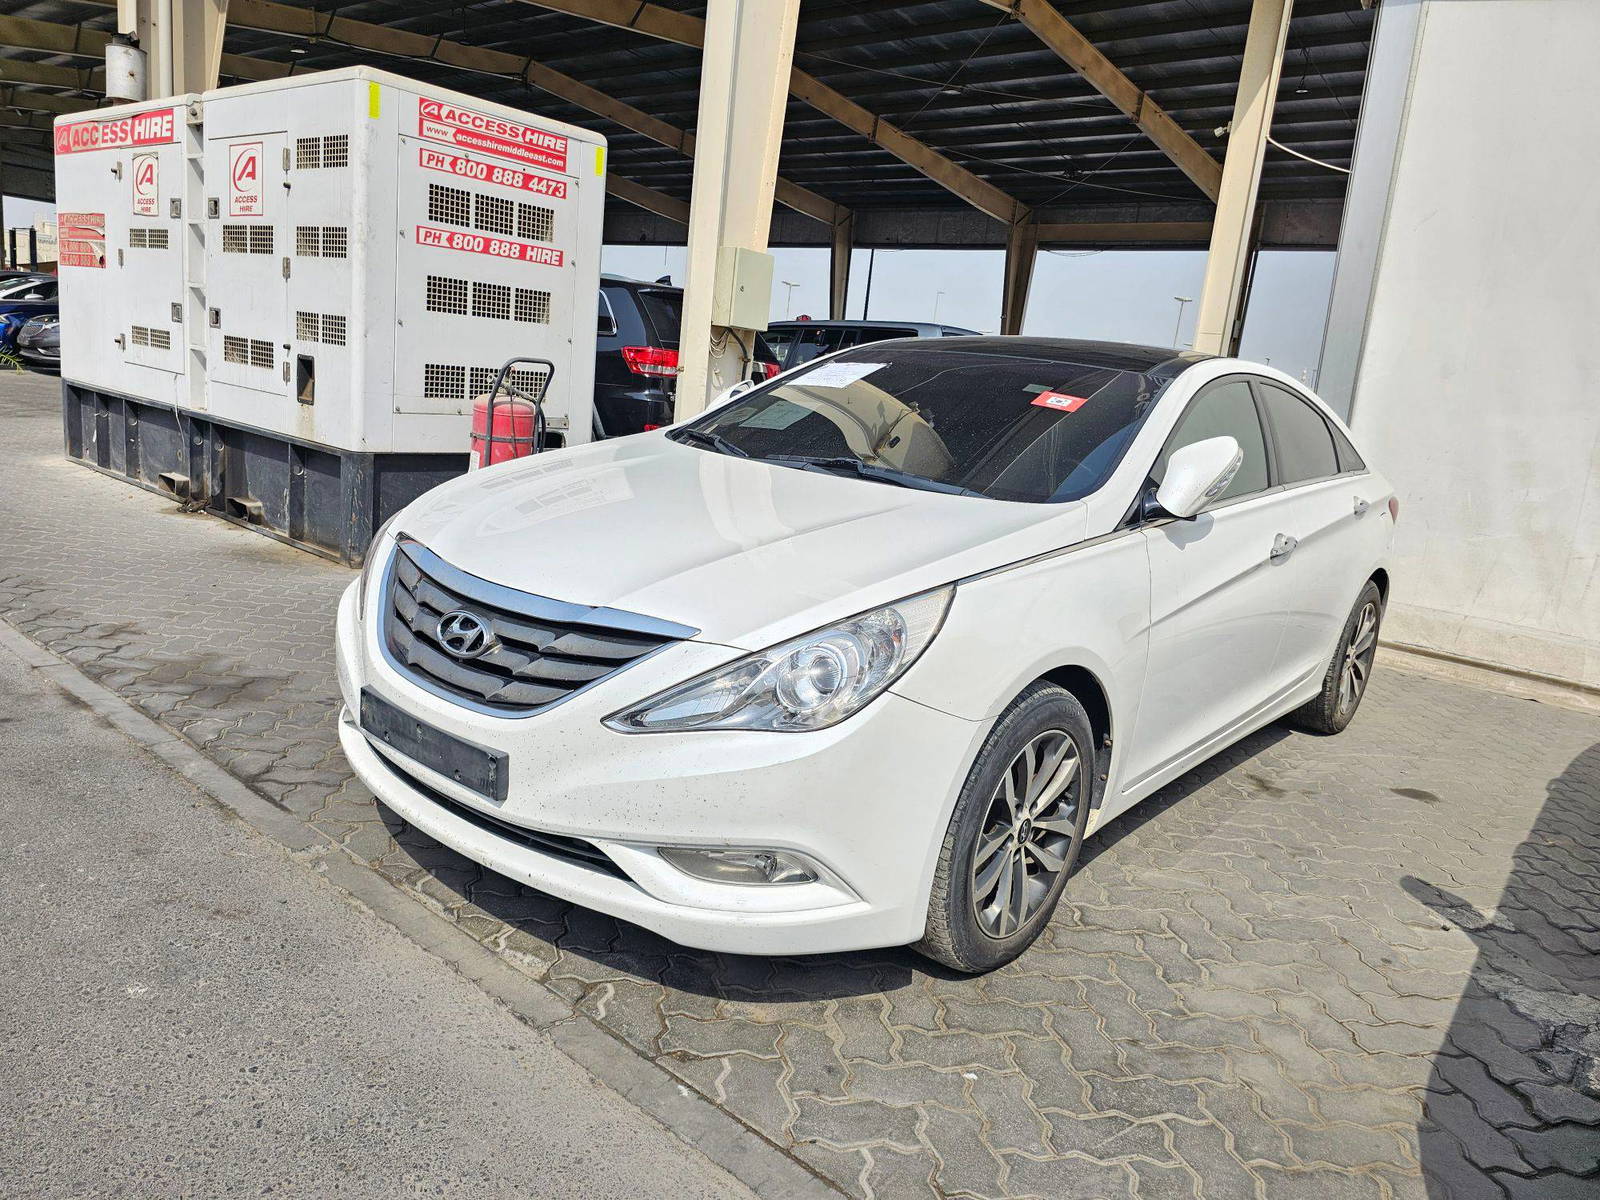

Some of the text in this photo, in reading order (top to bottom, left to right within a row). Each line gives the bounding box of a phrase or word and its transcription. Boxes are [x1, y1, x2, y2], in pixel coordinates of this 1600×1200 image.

[72, 121, 130, 147] ACCESS
[134, 115, 173, 140] HIRE
[426, 125, 564, 167] www accesshiremiddleeast.com
[445, 109, 520, 139] ACCESS
[525, 130, 567, 152] HIRE
[427, 153, 565, 198] PH 800 888 4473
[234, 195, 258, 204] ACCESS
[239, 205, 253, 213] HIRE
[423, 230, 561, 266] PH 800 888 HIRE
